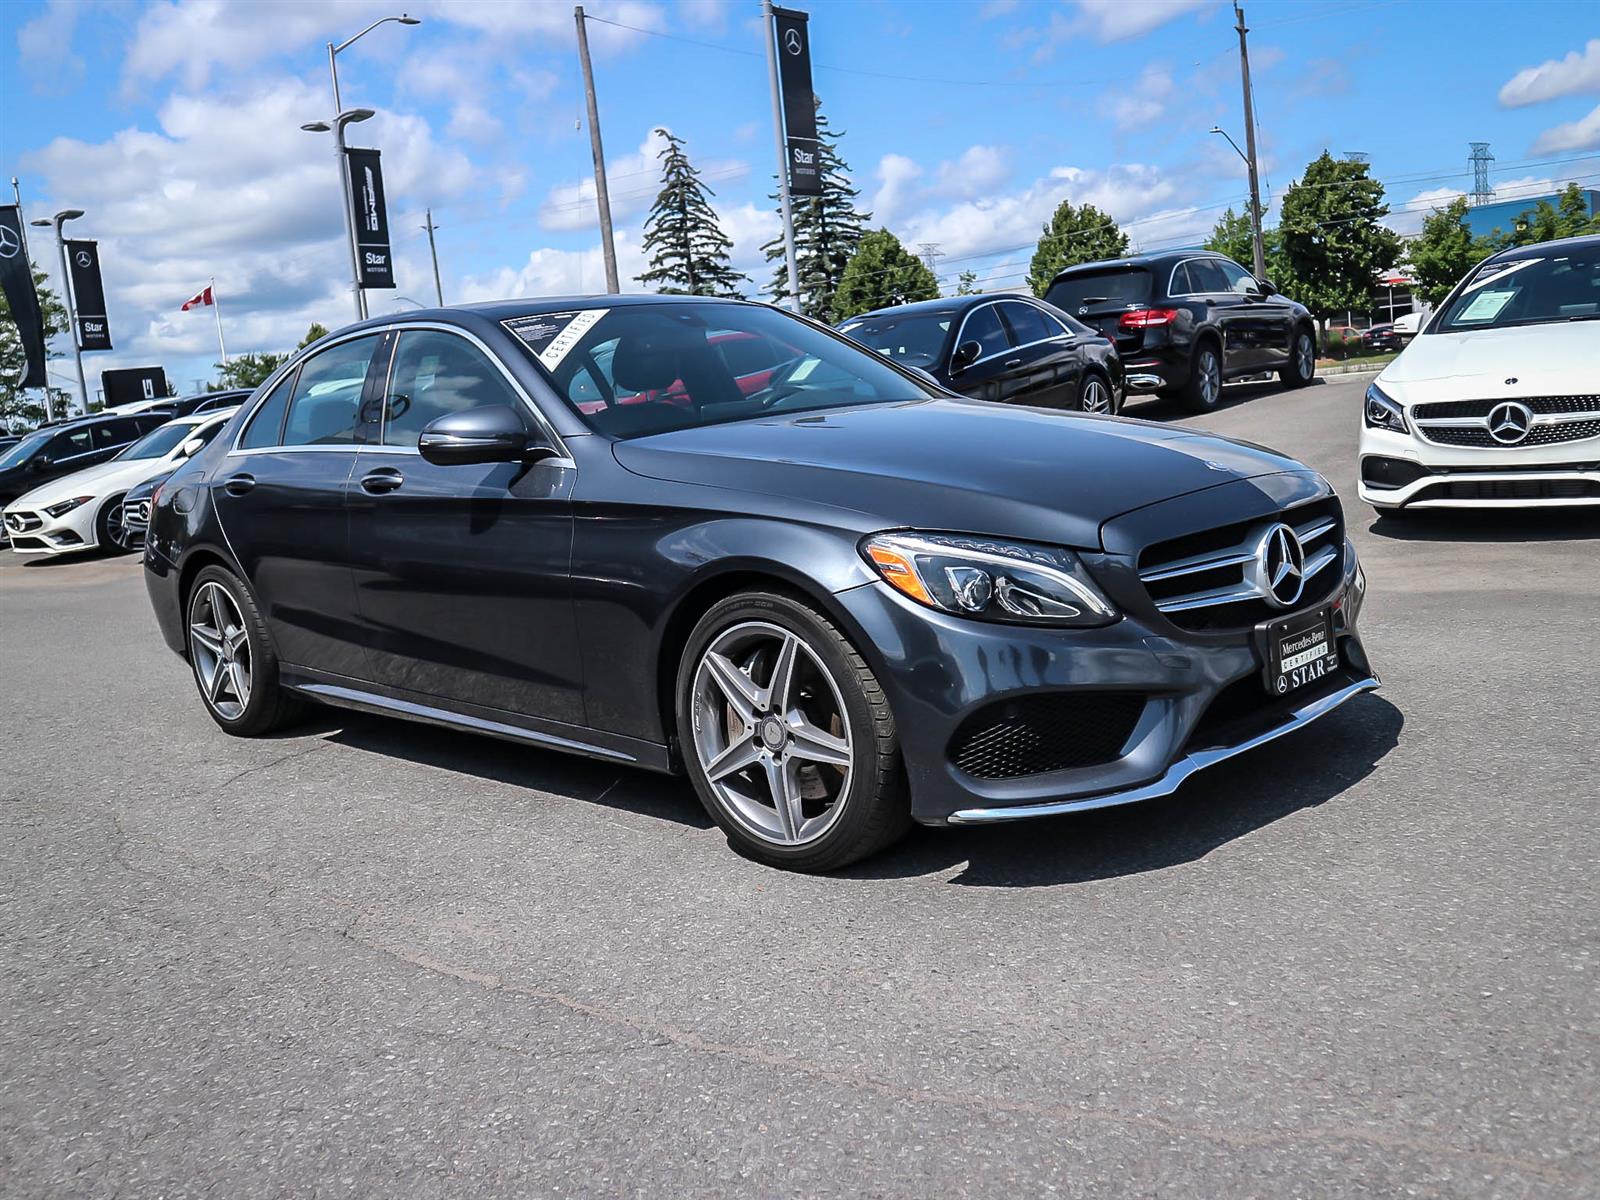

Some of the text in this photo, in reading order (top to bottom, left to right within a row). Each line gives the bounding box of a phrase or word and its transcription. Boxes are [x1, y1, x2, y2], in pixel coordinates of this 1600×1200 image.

[794, 148, 814, 164] Star
[366, 252, 386, 264] Star
[85, 322, 103, 332] Star
[545, 313, 595, 358] CERTIFIED
[1282, 631, 1325, 656] Mercedes-Benz
[1283, 645, 1326, 670] CERTIFIED
[1292, 660, 1326, 688] STAR
